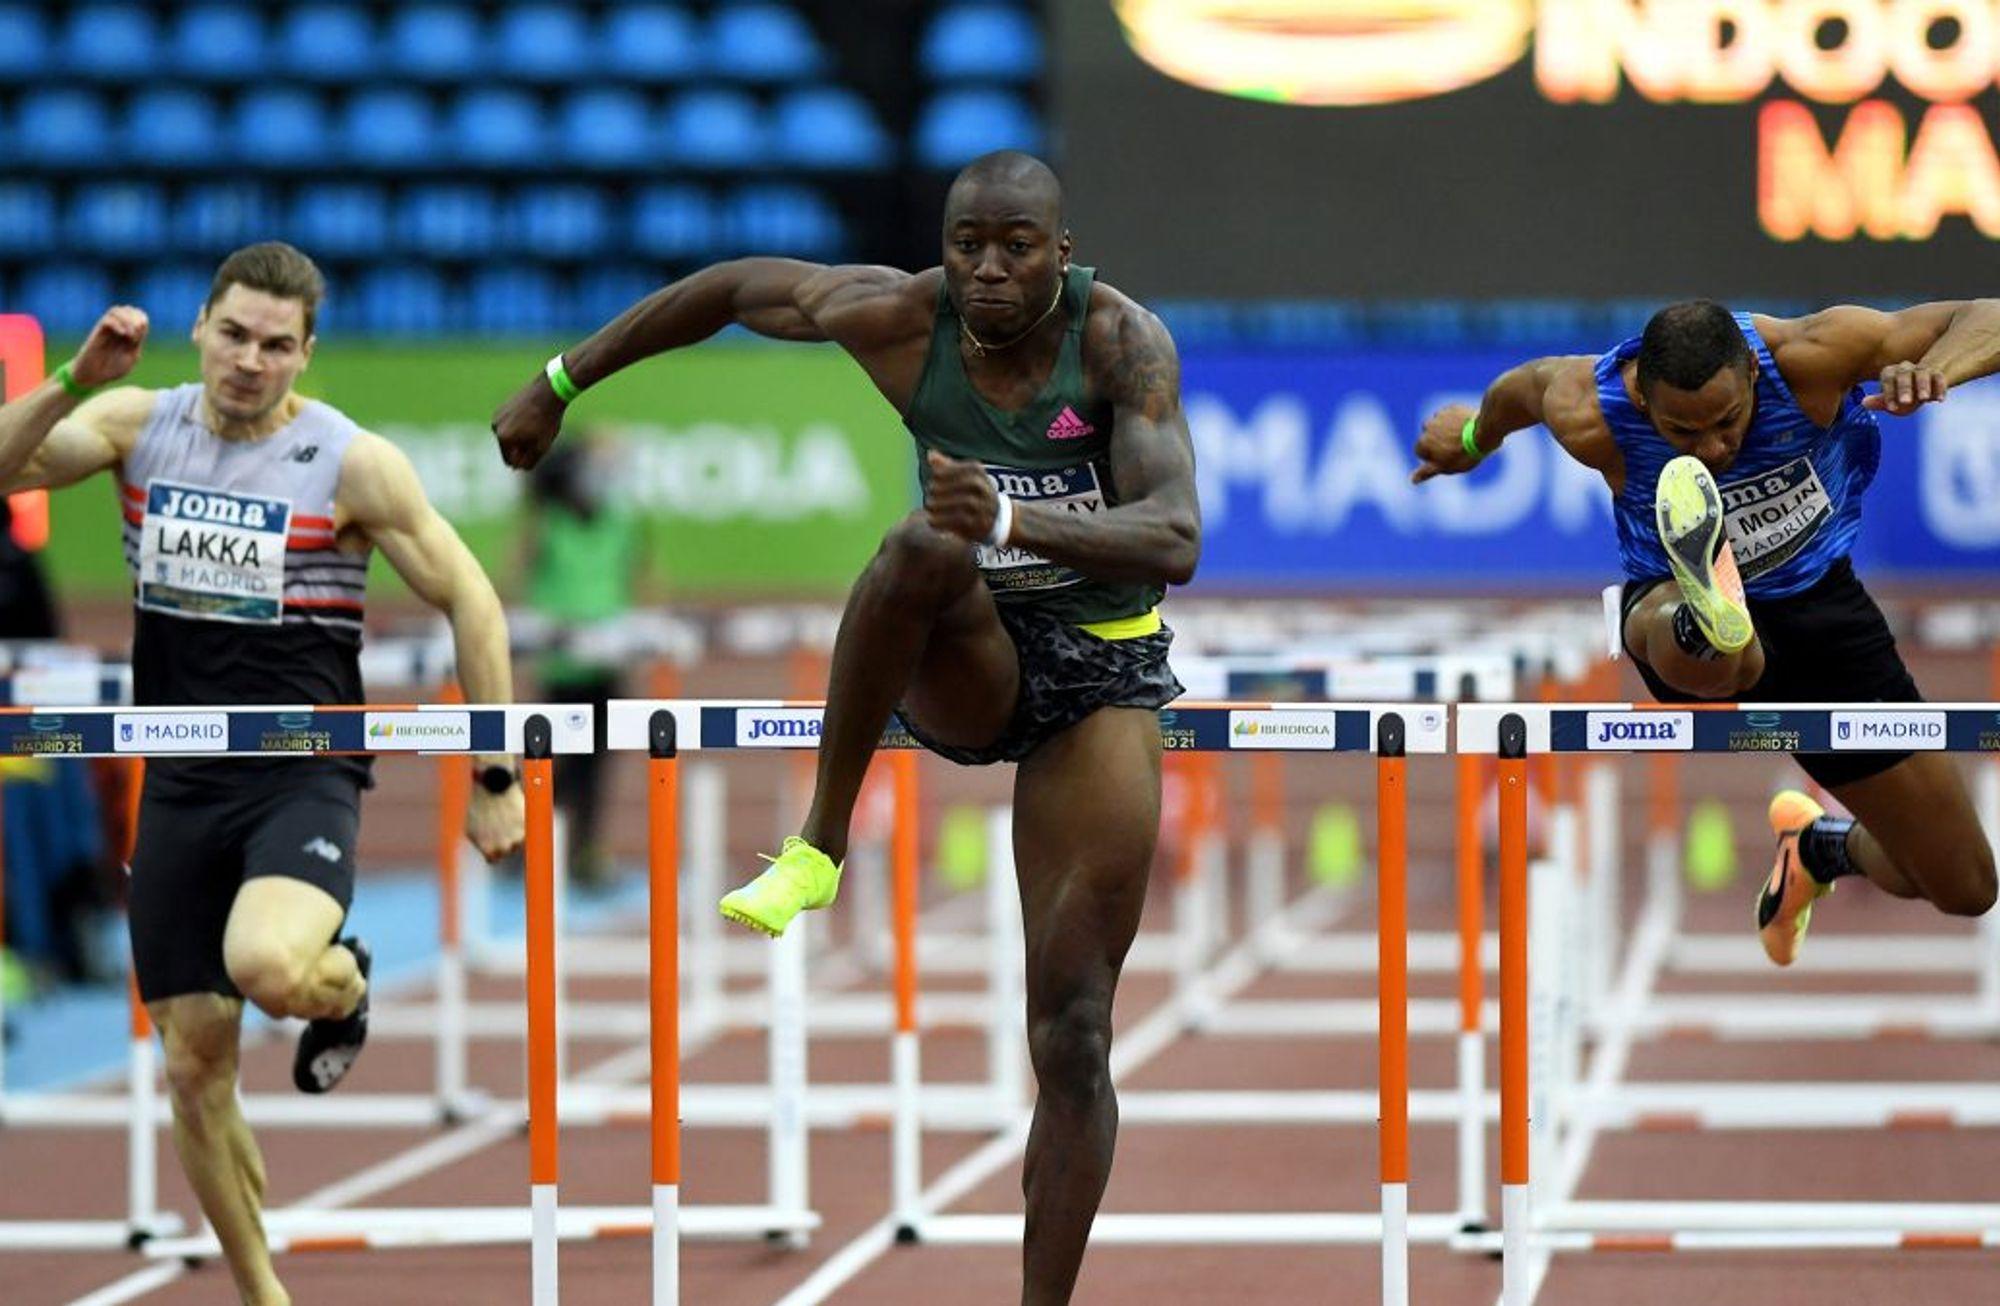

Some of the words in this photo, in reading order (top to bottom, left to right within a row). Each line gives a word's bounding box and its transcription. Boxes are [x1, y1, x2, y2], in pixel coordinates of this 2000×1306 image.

[1533, 0, 2000, 103] INDOO
[1046, 423, 1094, 439] adidas
[1738, 481, 1818, 536] MOLIN
[1735, 504, 1816, 562] MADRID
[157, 526, 261, 569] LAKKA
[180, 565, 267, 592] MADRID
[145, 724, 224, 740] MADRID
[396, 725, 466, 737] IBERDROLA
[1260, 724, 1330, 735] IBERDROLA
[1862, 723, 1942, 738] MADRID
[12, 741, 65, 753] MADRID
[67, 741, 83, 752] 21
[261, 739, 313, 750] MADRID
[315, 739, 330, 750] 21
[1180, 737, 1195, 748] 21
[1728, 739, 1781, 750] MADRID
[1784, 739, 1799, 750] 21
